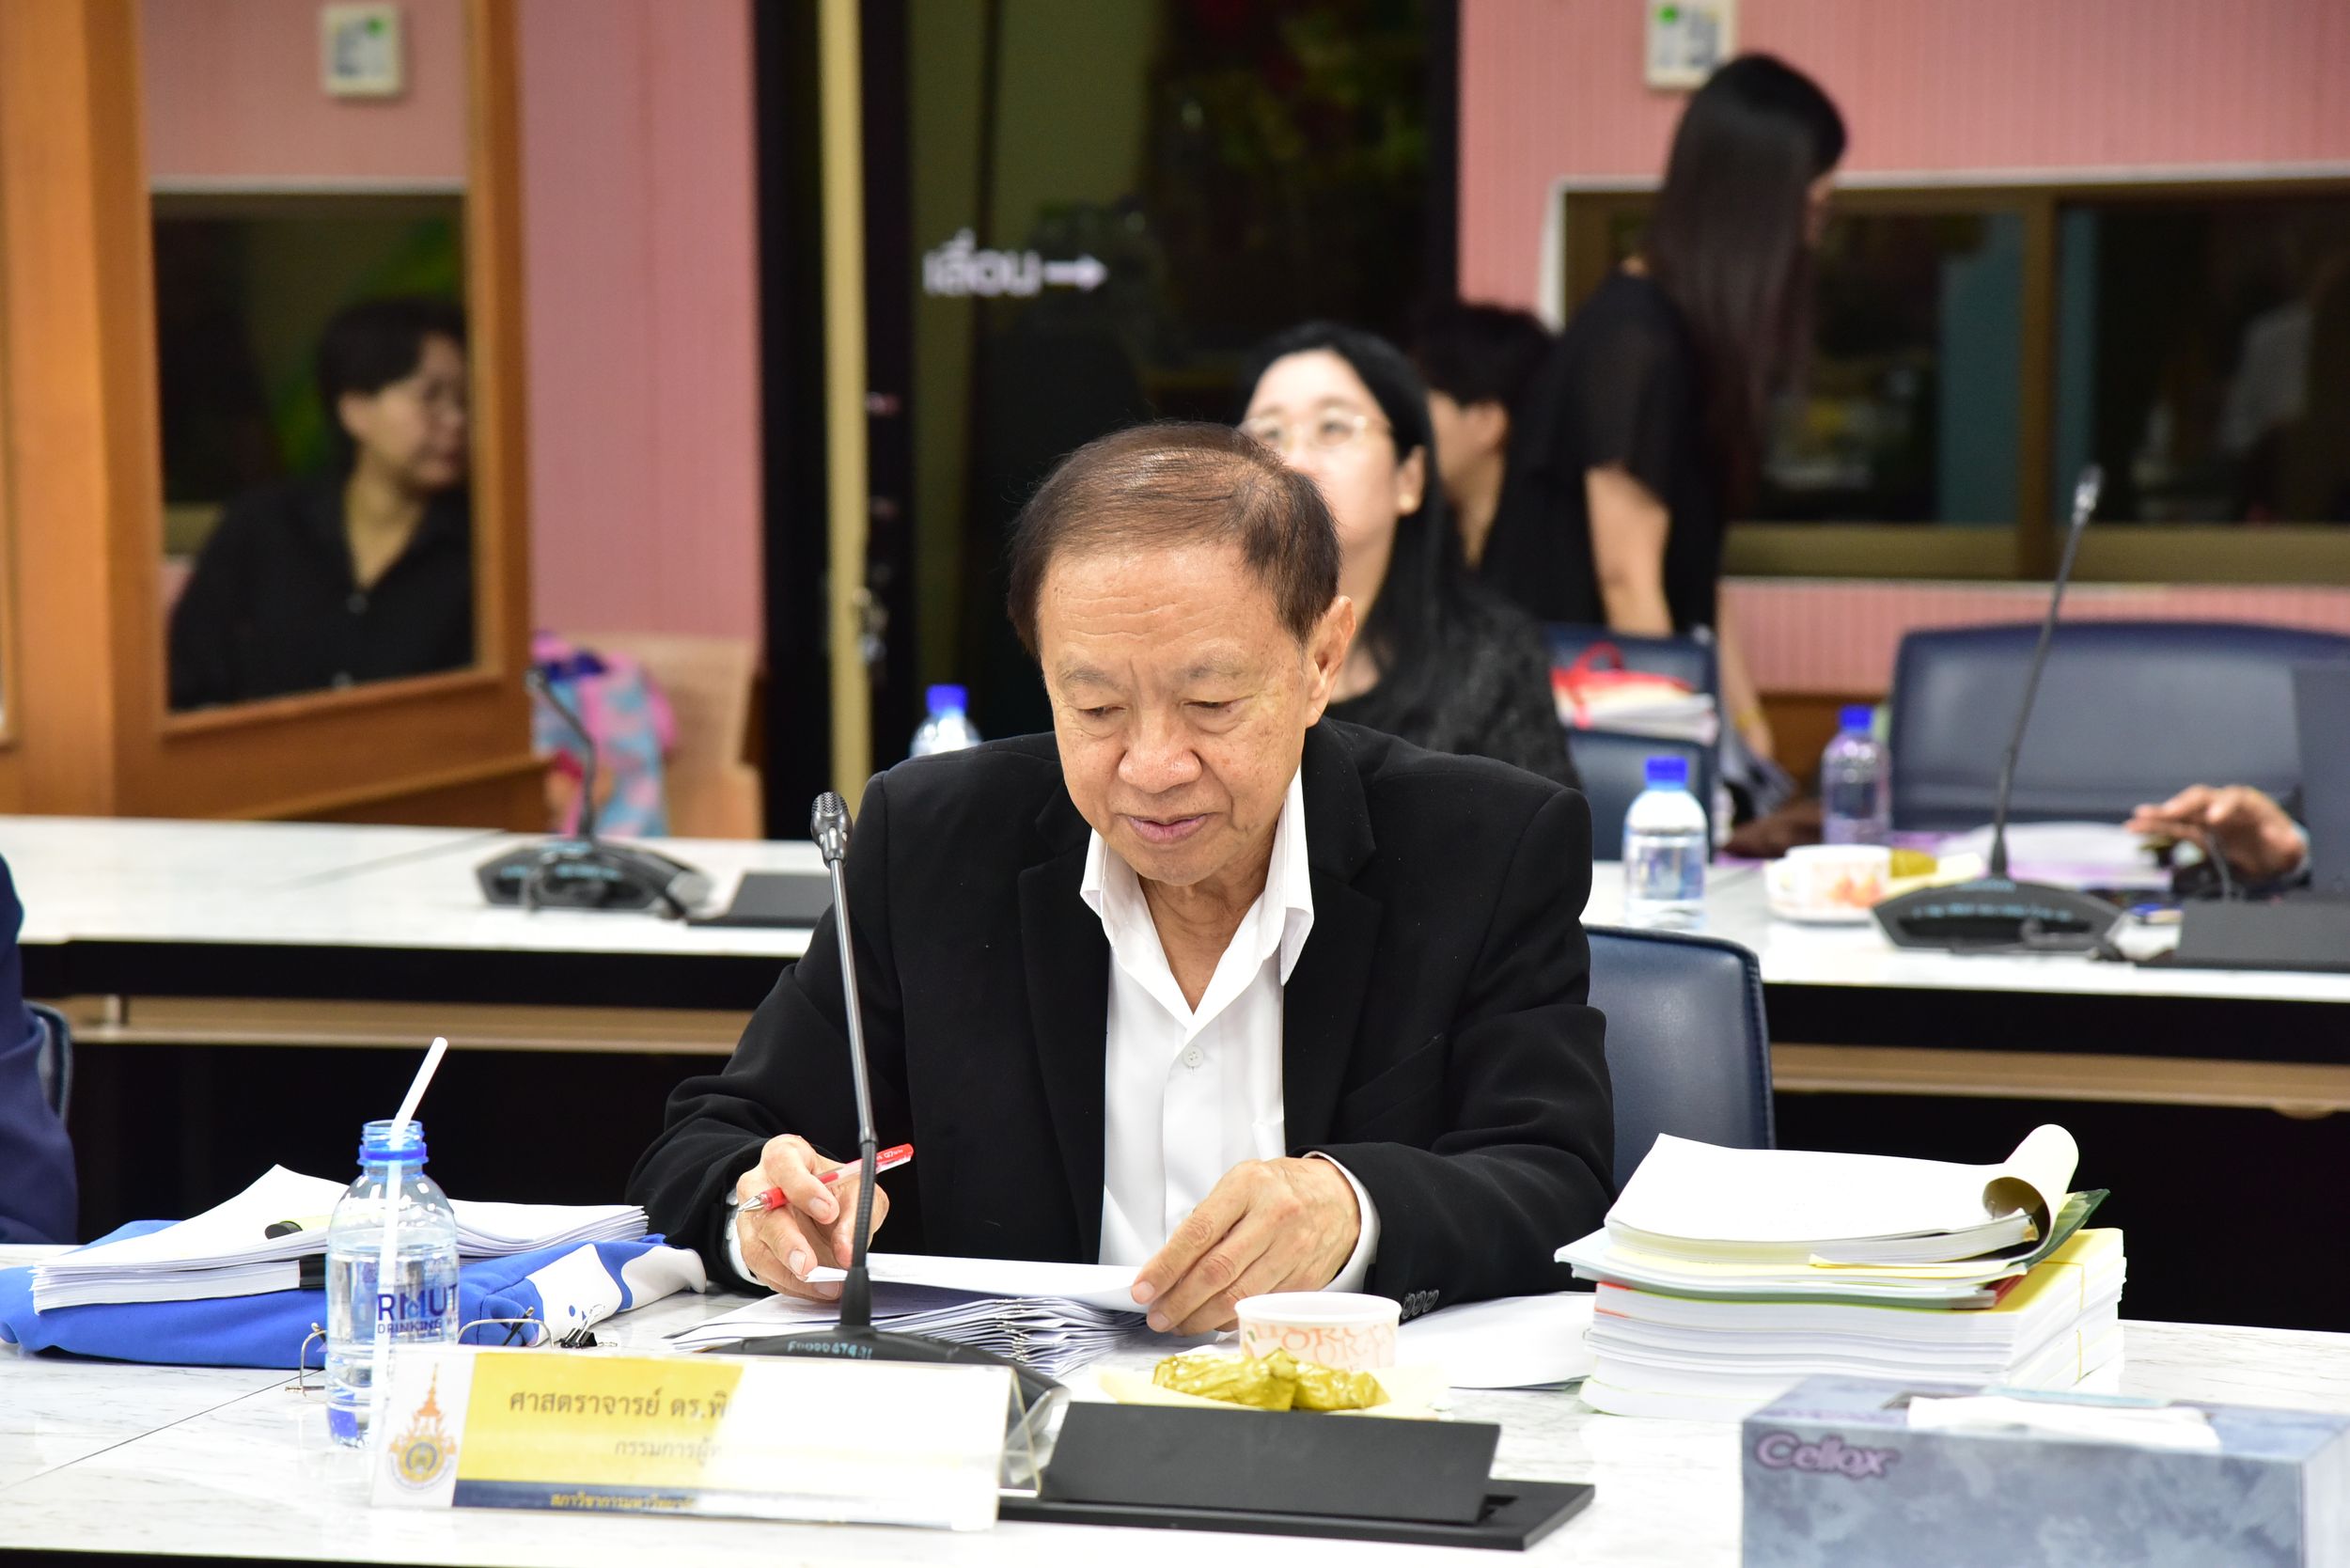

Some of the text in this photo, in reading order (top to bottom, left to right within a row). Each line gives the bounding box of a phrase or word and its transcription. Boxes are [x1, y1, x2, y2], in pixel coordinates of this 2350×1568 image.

[377, 1318, 442, 1334] DRINKING
[509, 1387, 728, 1419] ศาสตราจารย์ ดร.พิ
[1755, 1430, 1902, 1480] Cellox
